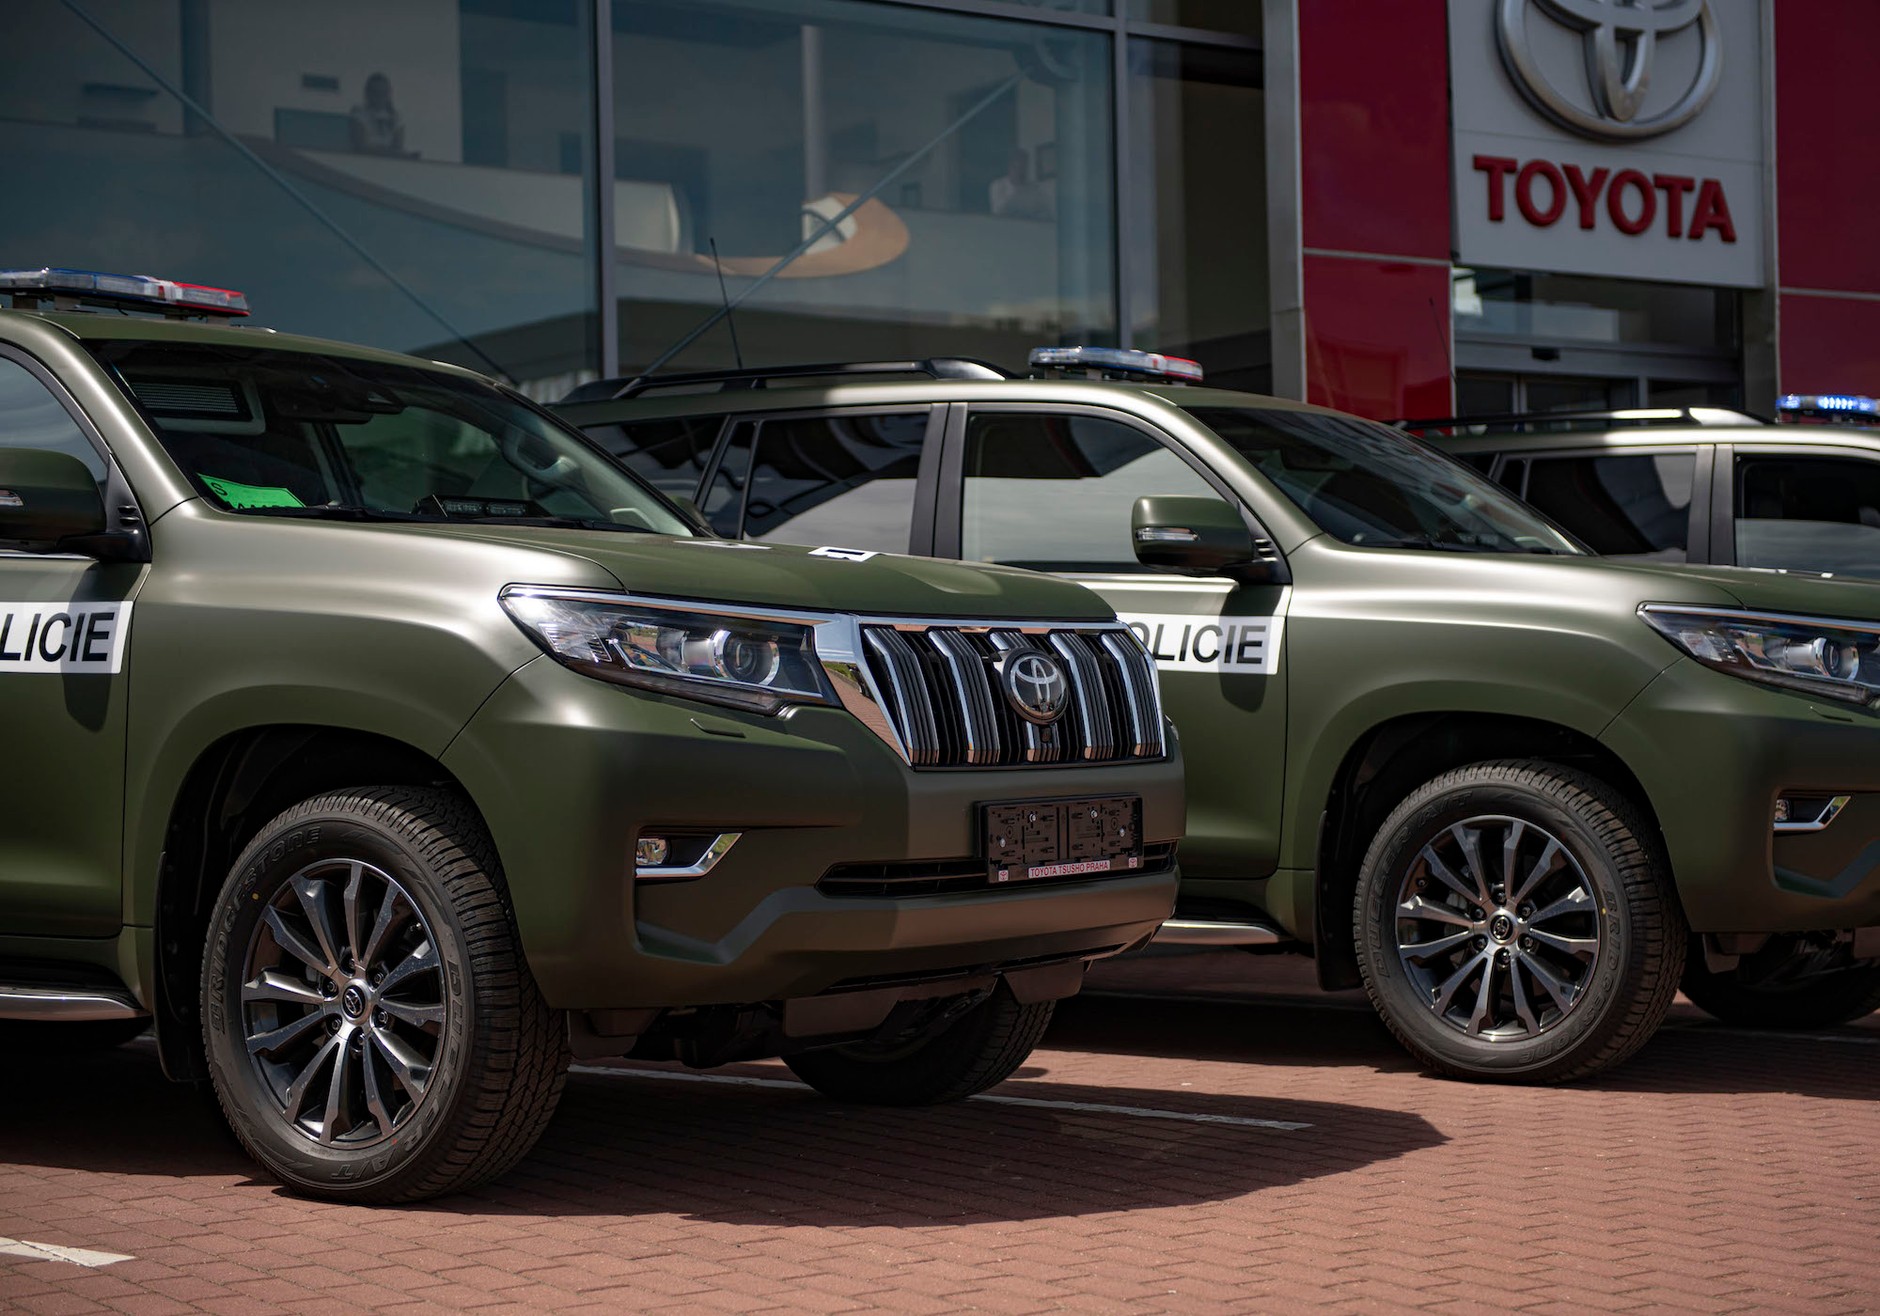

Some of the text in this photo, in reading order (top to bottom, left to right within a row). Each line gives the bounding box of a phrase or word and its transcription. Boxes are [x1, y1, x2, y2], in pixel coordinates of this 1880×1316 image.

[1472, 154, 1736, 243] TOYOTA
[0, 612, 115, 662] LICIE
[1031, 861, 1108, 877] TOYOTA TSUSHO PRAHA
